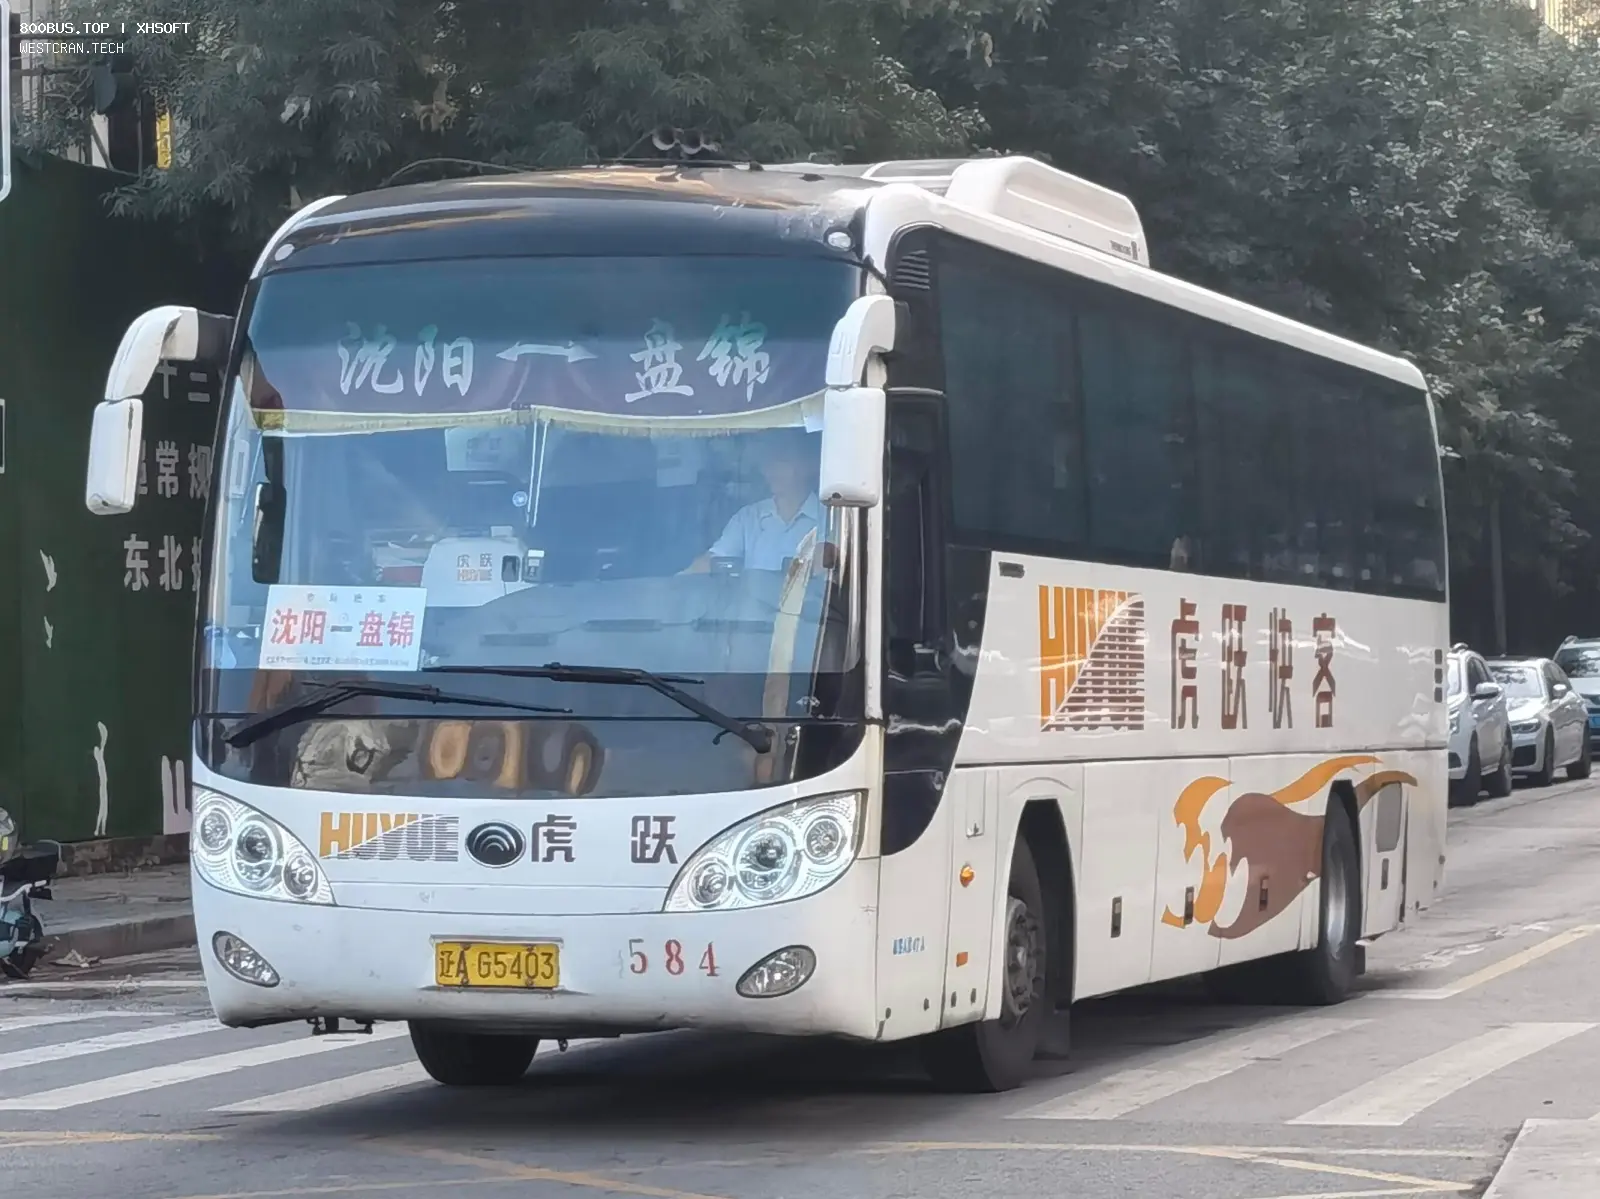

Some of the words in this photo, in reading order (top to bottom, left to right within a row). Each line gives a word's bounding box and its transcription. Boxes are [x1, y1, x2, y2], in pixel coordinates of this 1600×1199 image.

[338, 320, 475, 397] 沈阳
[625, 310, 771, 402] 盘锦
[1170, 597, 1336, 730] 虎跃快客
[319, 811, 460, 862] HUYUE
[530, 813, 679, 864] 虎跃
